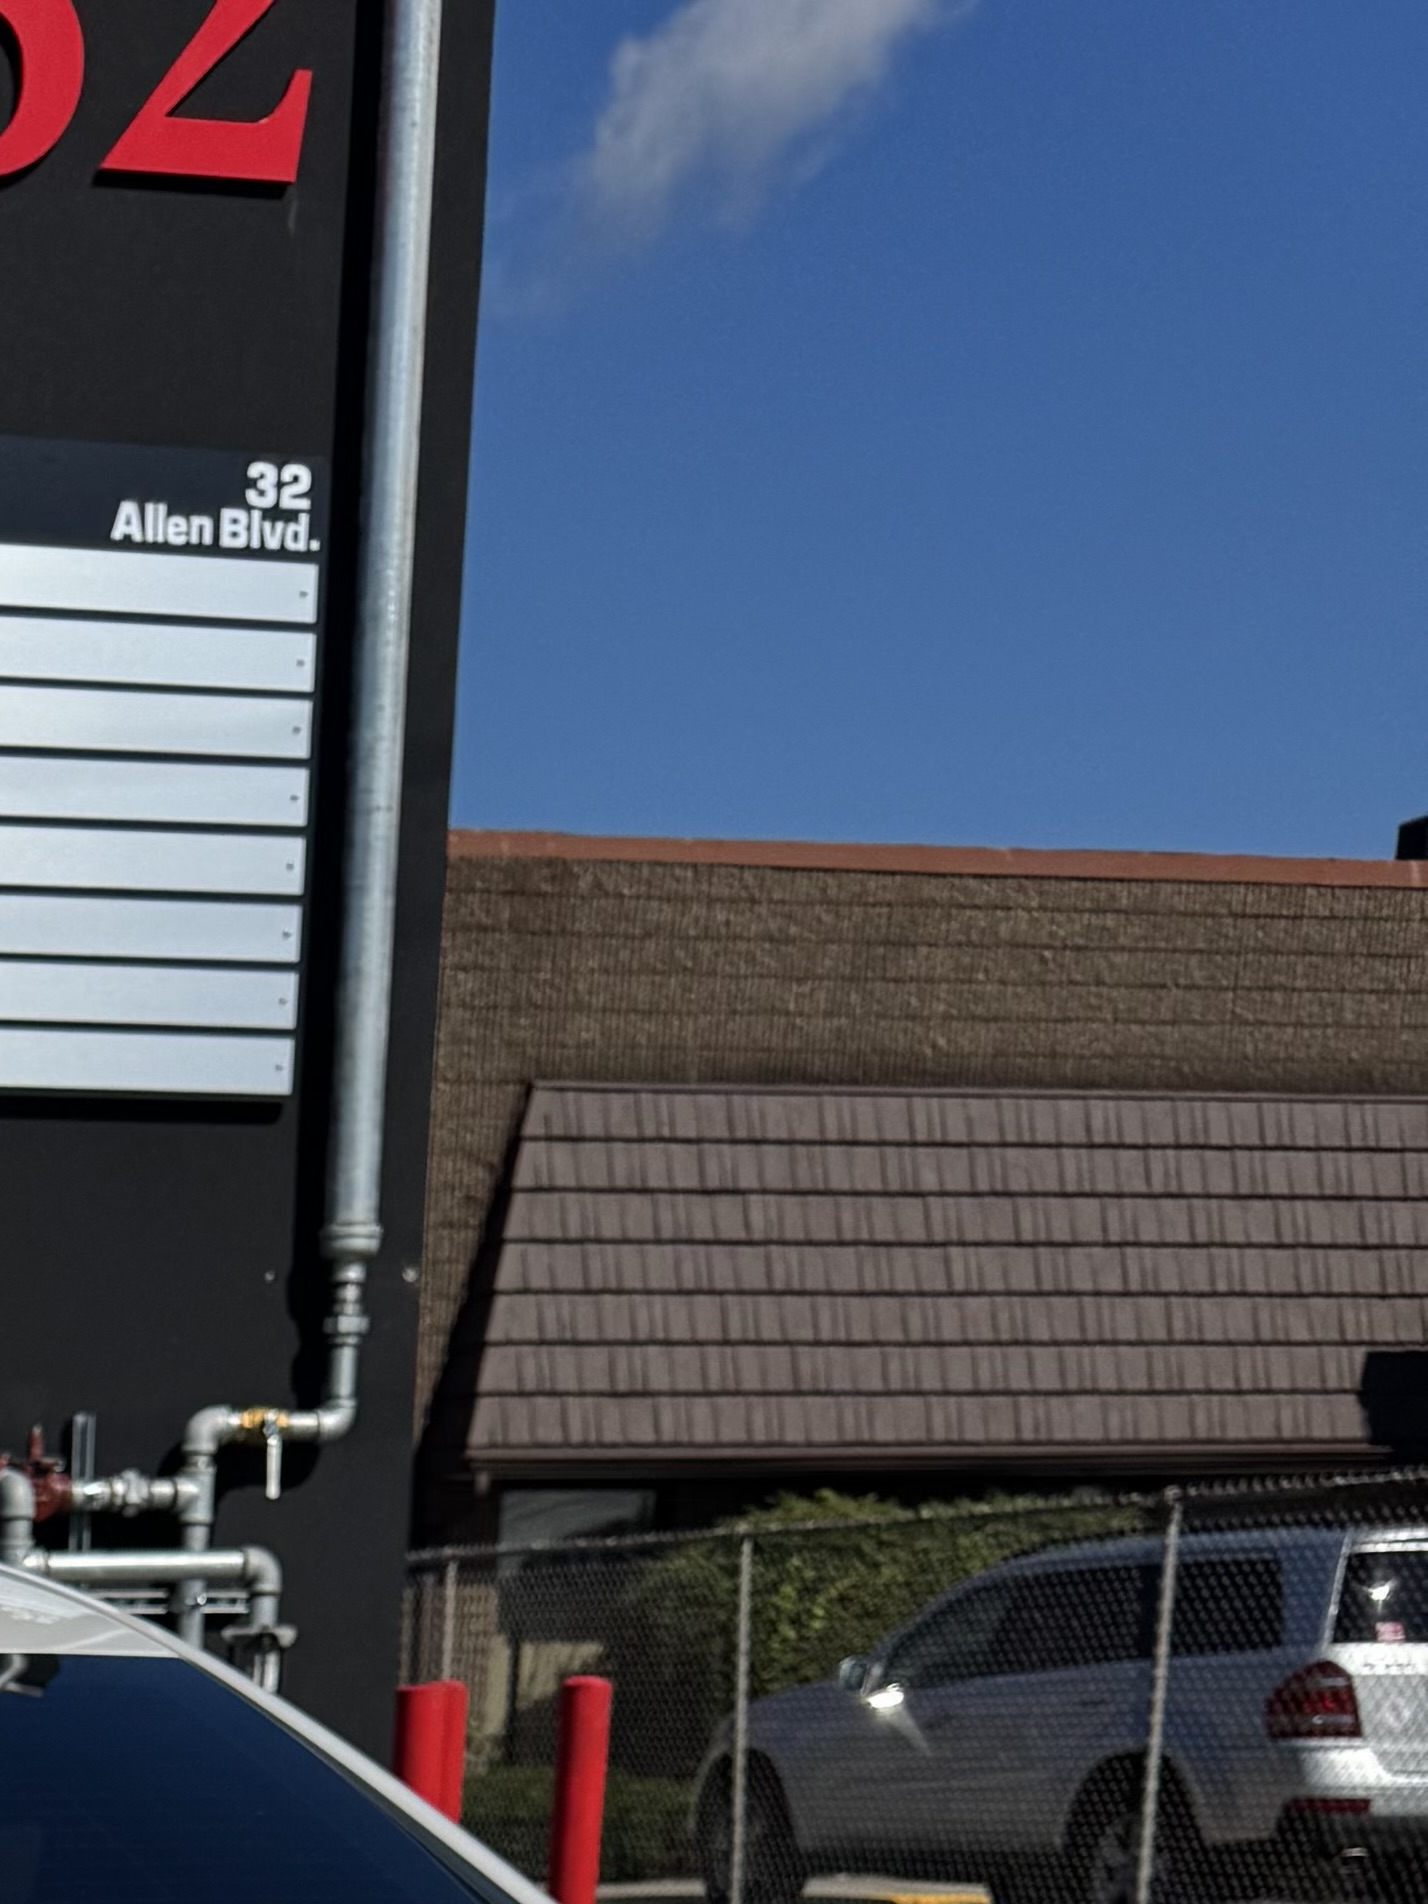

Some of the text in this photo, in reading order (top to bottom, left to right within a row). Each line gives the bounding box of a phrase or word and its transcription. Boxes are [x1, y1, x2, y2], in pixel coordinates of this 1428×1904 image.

[245, 461, 312, 510] 32
[110, 500, 321, 552] Allen Blvd.
